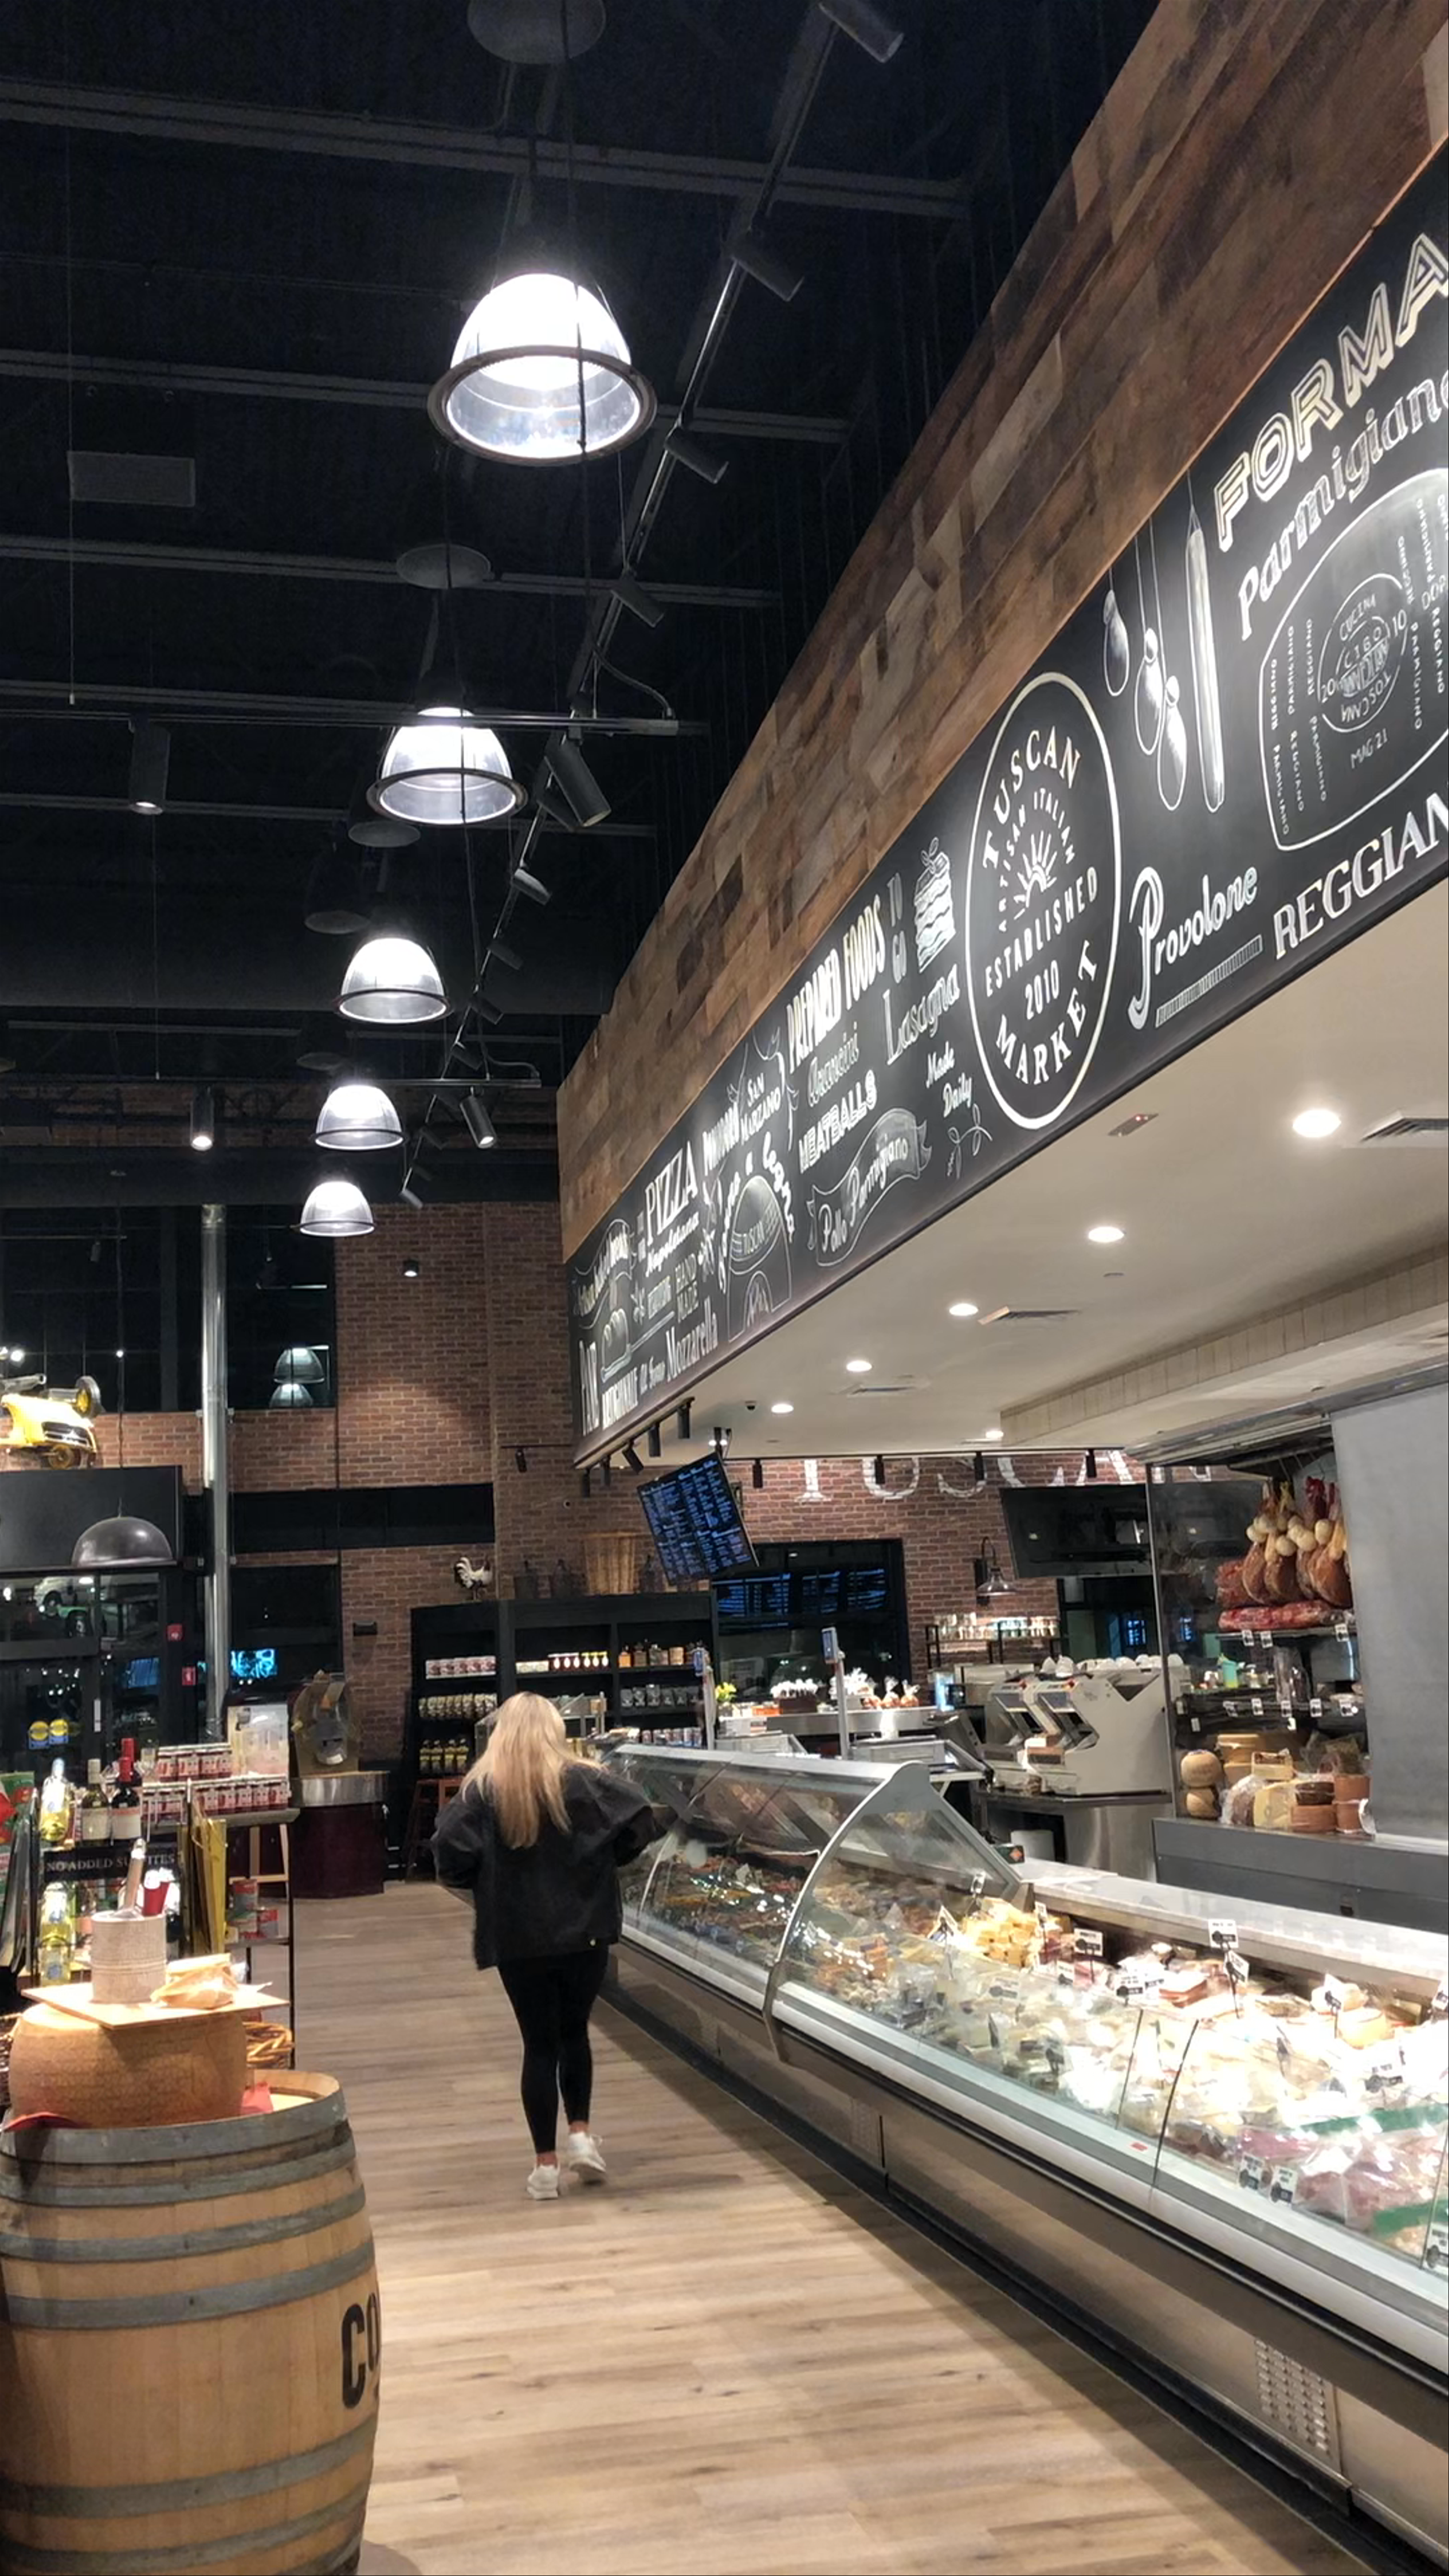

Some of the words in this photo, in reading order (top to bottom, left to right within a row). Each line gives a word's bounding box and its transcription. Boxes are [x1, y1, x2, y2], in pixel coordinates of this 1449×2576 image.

[1213, 232, 1449, 552] FORMA
[1306, 618, 1315, 695] REGGIANO
[1321, 678, 1335, 703] 20
[1393, 609, 1407, 638] 10
[1340, 594, 1376, 640] CUCINA
[1432, 607, 1445, 694] REGGIANO
[1287, 626, 1295, 715] PARMIGIANO
[1411, 622, 1422, 730] PARMIGIANO
[983, 726, 1080, 870] TUSCAN
[1272, 744, 1289, 835] PARMIGIANO
[1290, 730, 1304, 812] REGGIANO
[1309, 716, 1327, 801] PARMIGIANO
[999, 804, 1026, 932] ARTISAN
[1034, 789, 1074, 864] ITALIAN
[985, 866, 1097, 998] ESTABLISHED
[1128, 867, 1257, 1029] Provolone
[786, 948, 842, 1075] PREPARED
[844, 894, 886, 1010] FOODS
[882, 964, 960, 1066] Lasagna
[995, 940, 1097, 1085] MARKET
[1025, 960, 1060, 1020] 2010
[926, 1041, 955, 1088] Made
[943, 1074, 972, 1118] Daily
[799, 1069, 877, 1175] MEATBALLS
[645, 1141, 698, 1246] PIZZA
[820, 1204, 848, 1252] Pollo
[846, 1133, 909, 1227] Parmigiano
[666, 1296, 718, 1383] Mozzarella
